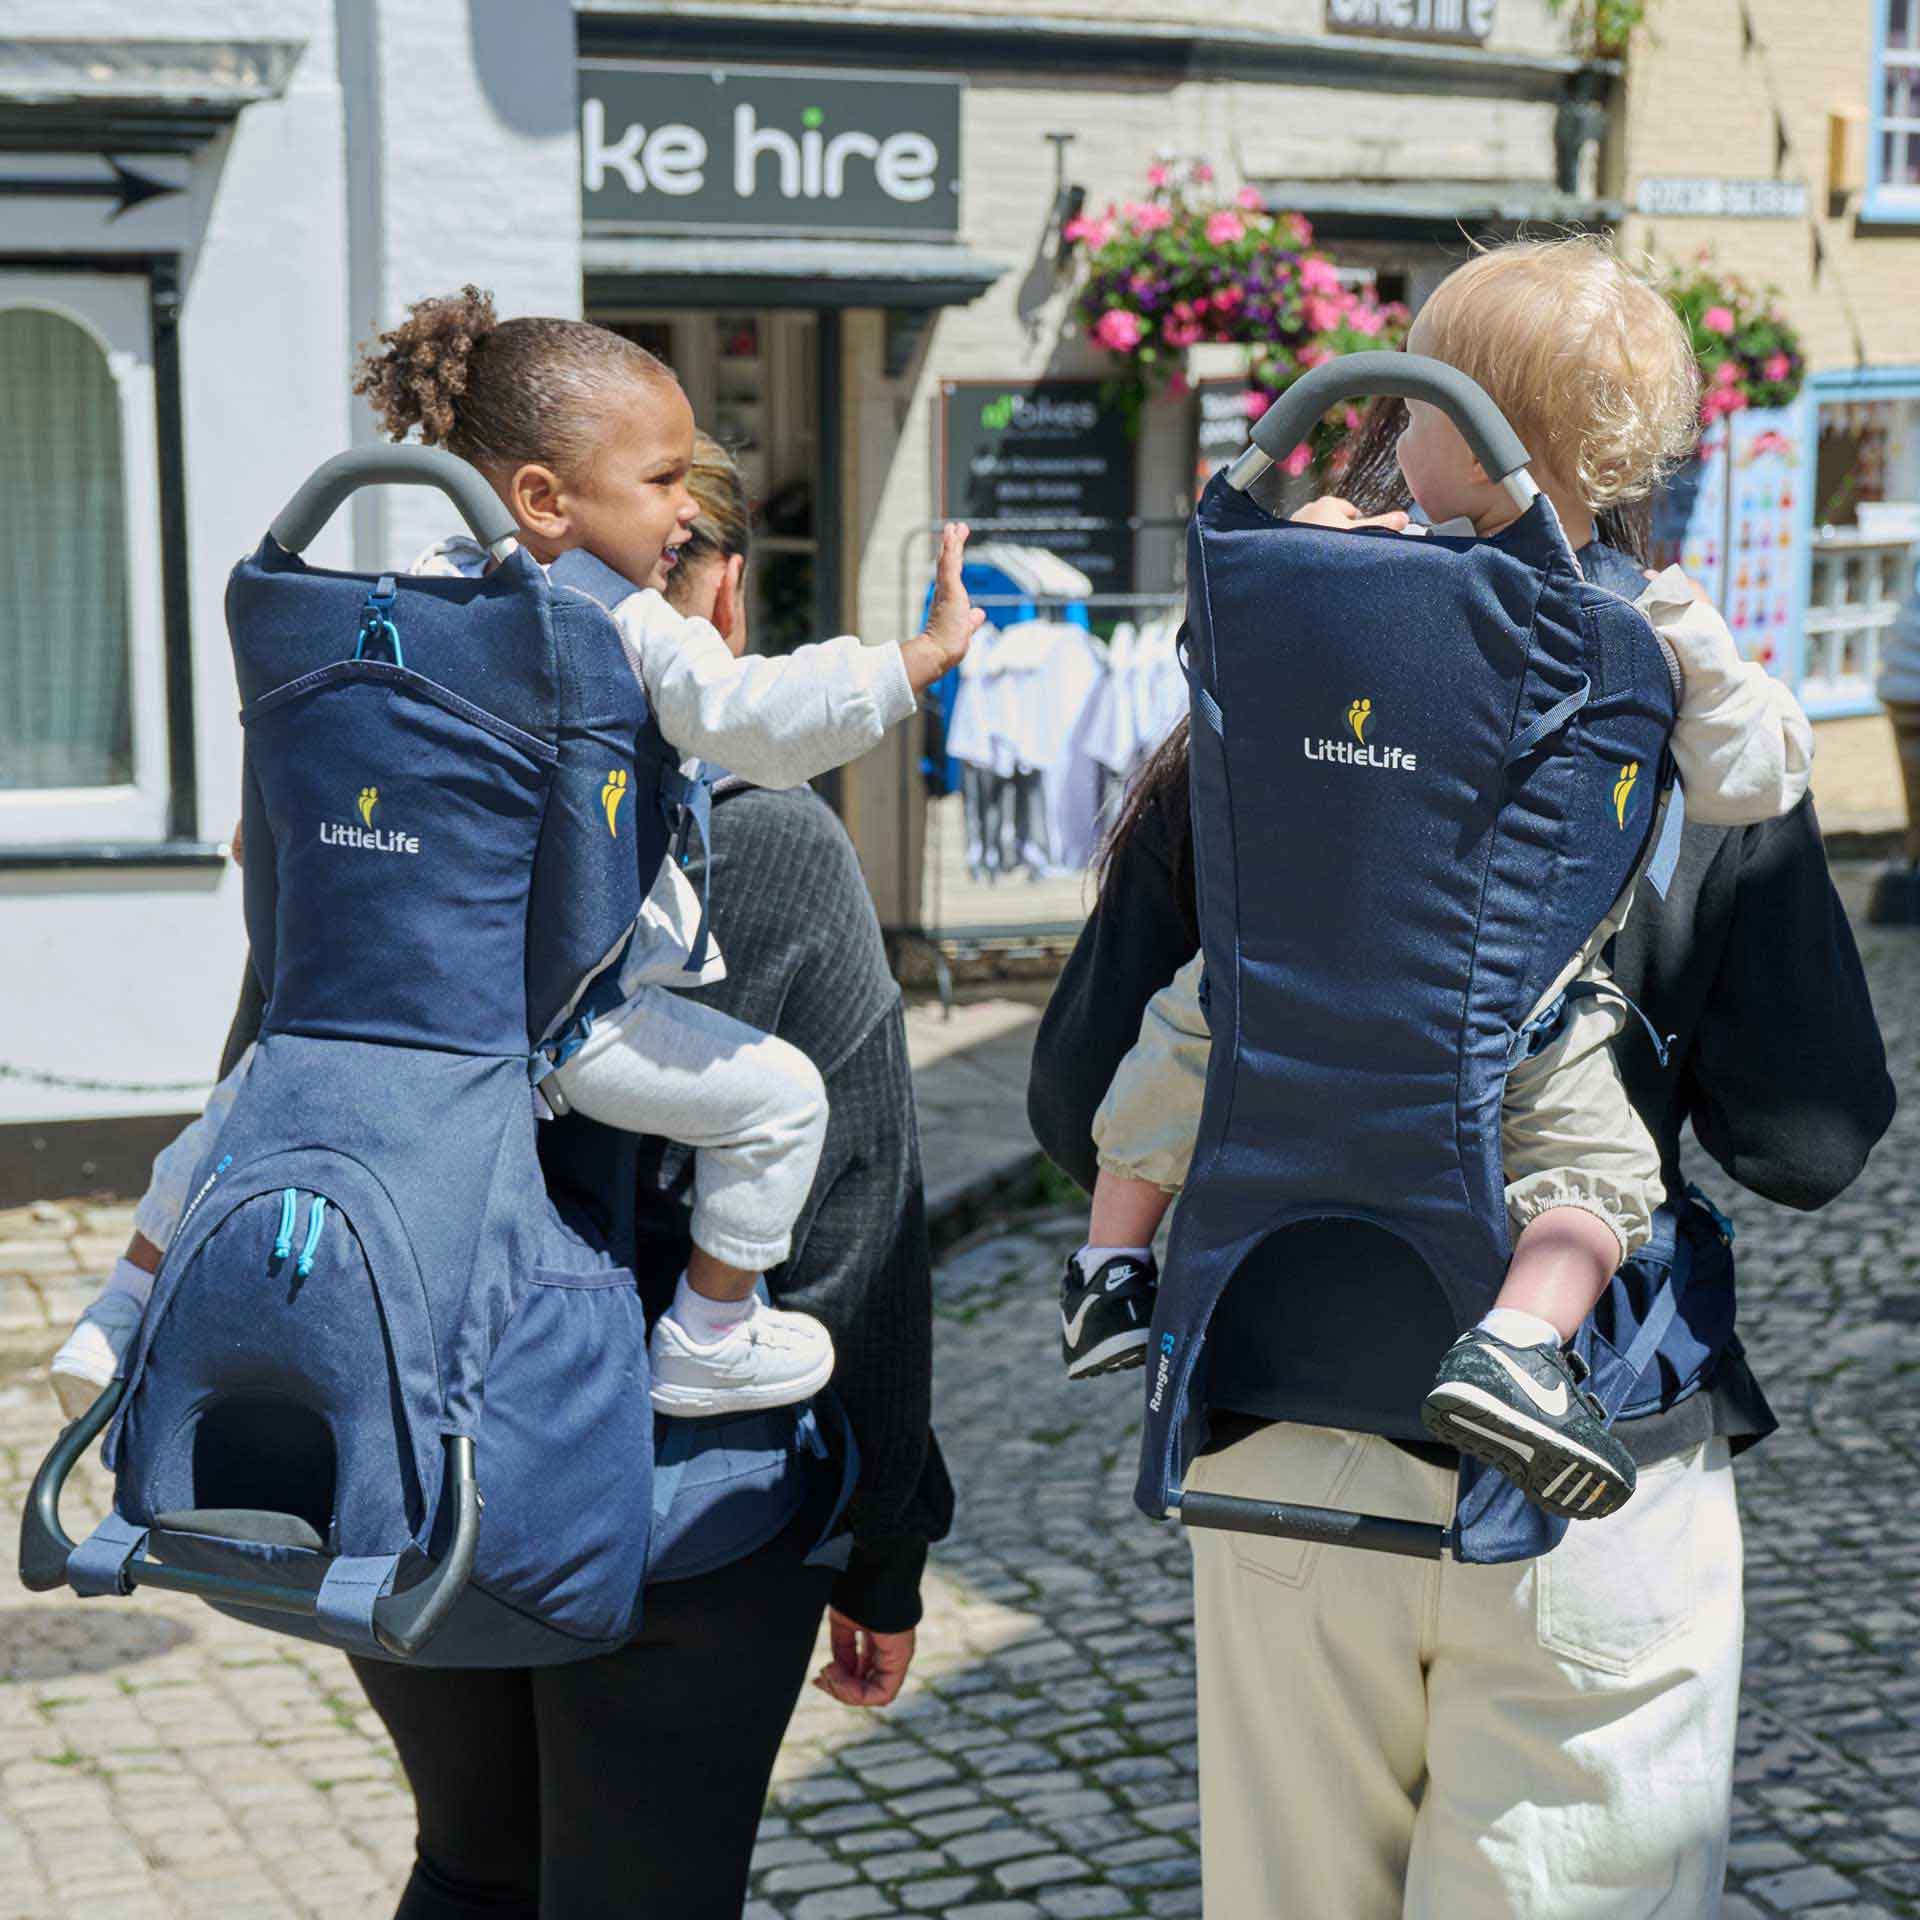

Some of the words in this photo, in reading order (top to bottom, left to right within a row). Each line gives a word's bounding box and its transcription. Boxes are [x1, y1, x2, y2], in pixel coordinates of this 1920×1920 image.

[734, 103, 939, 201] hire
[1304, 737, 1417, 771] LittleLife
[320, 822, 420, 853] LittleLife
[1149, 1353, 1170, 1412] Ranger
[1161, 1331, 1175, 1355] S3
